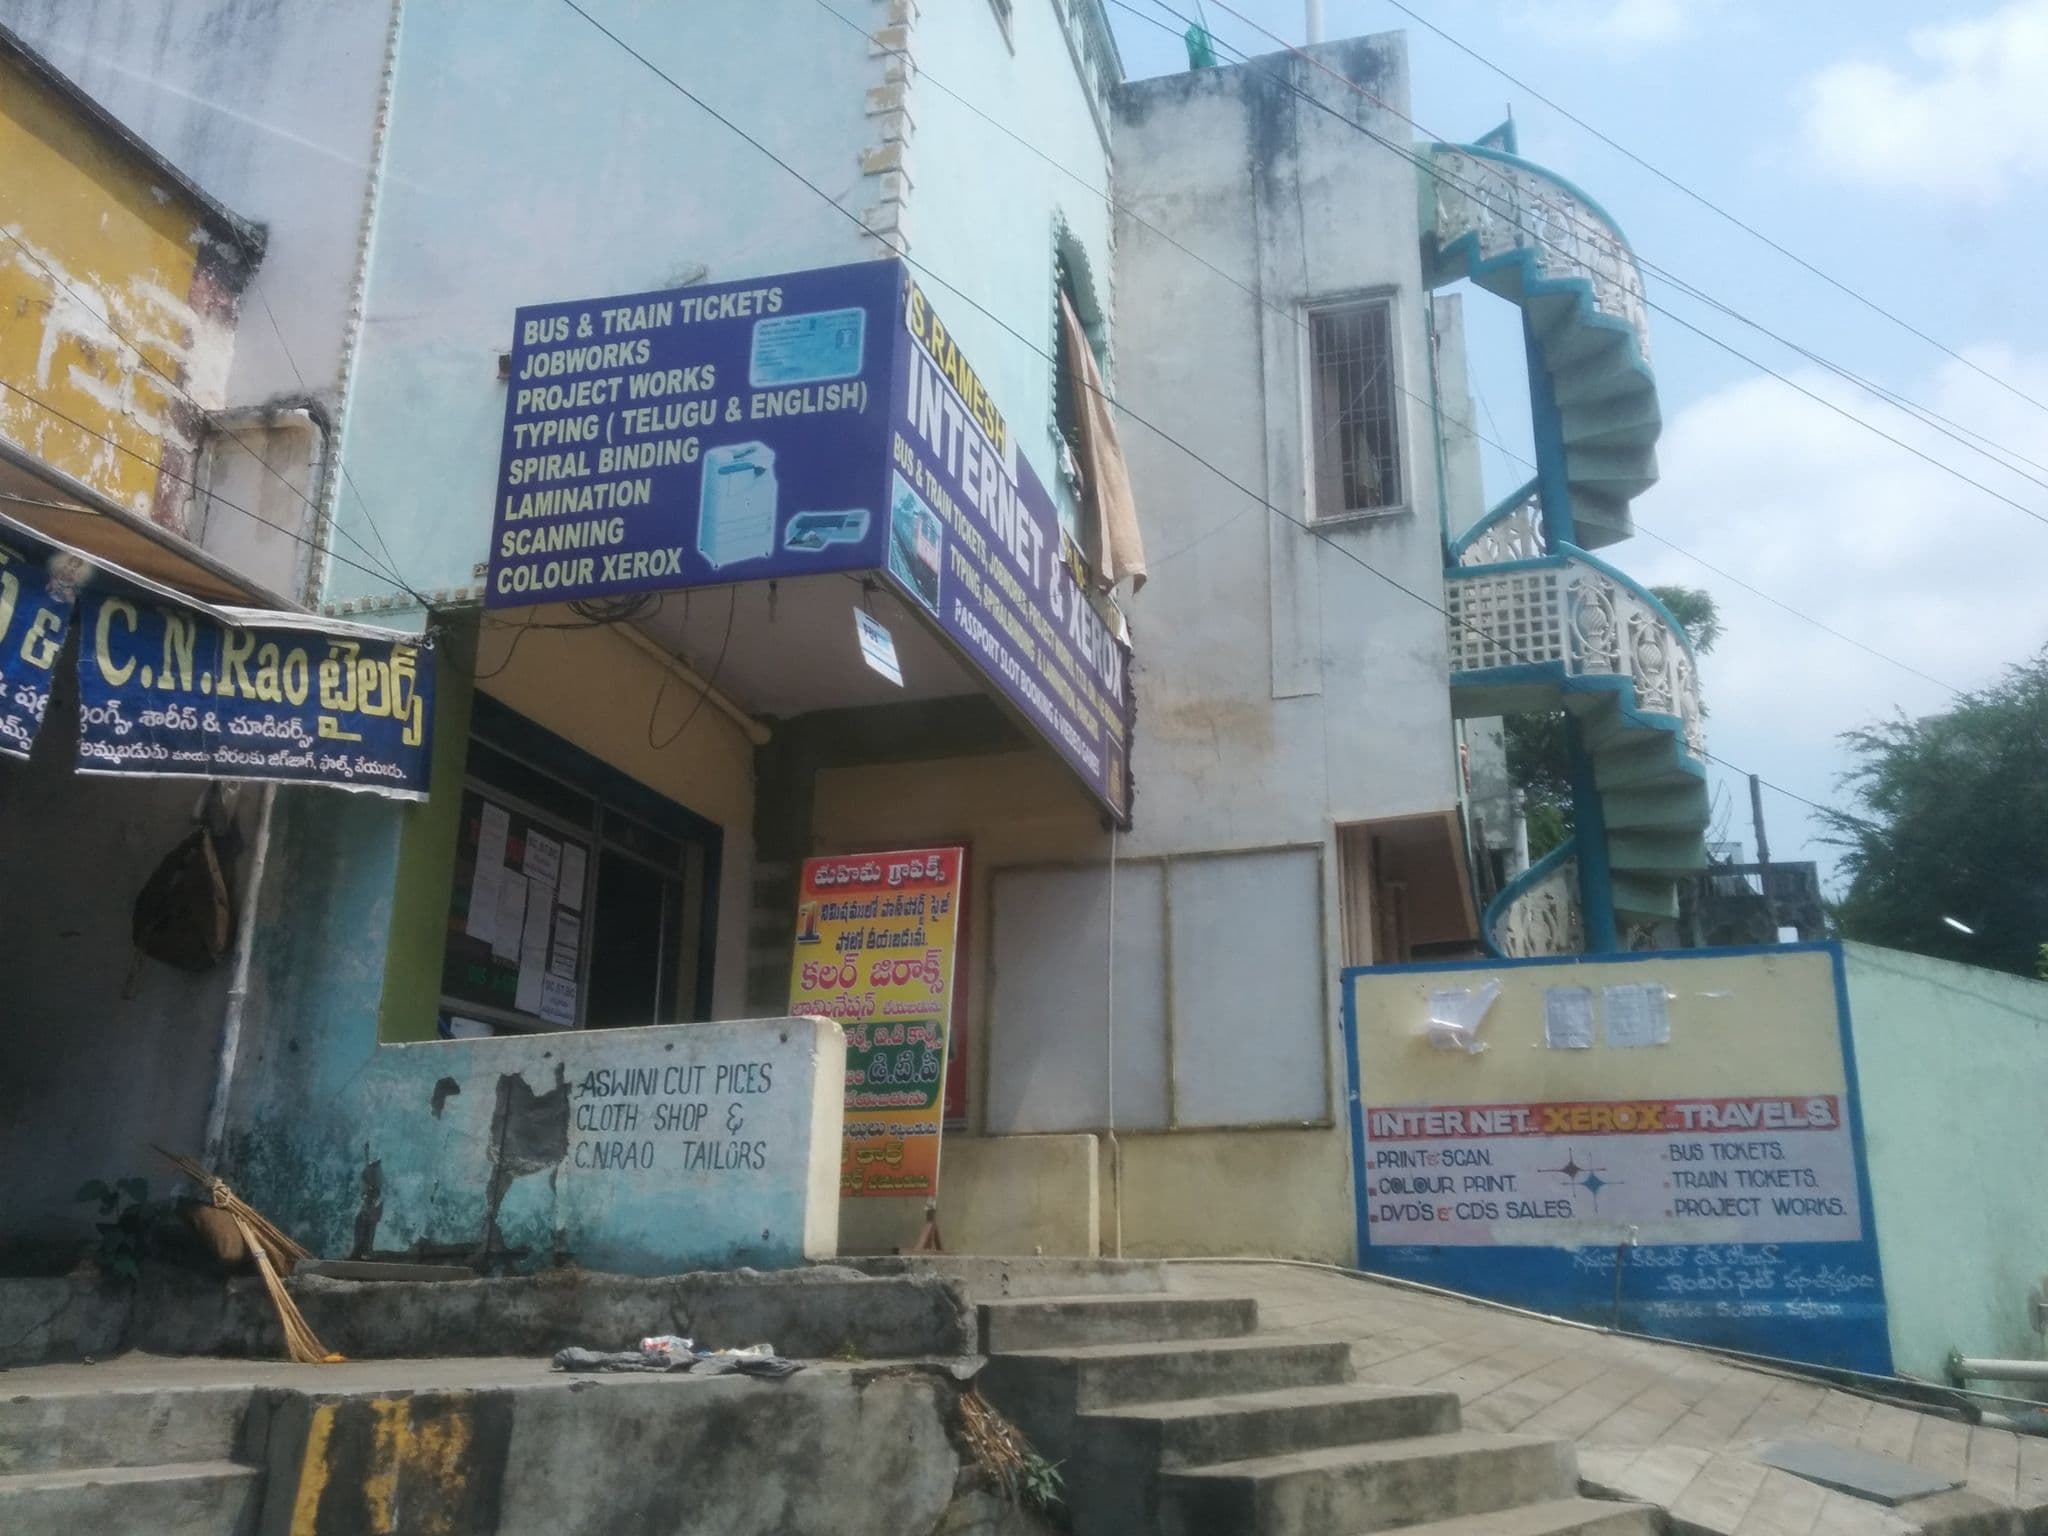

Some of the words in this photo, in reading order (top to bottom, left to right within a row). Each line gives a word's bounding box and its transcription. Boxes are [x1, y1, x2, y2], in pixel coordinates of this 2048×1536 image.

[523, 316, 569, 345] BUS
[577, 313, 593, 338] &
[602, 301, 672, 335] TRAIN
[680, 287, 783, 324] TICKETS
[519, 339, 650, 381] JOBWORKS
[911, 287, 1007, 461] S.RAMESH
[516, 376, 622, 414] PROJECT
[629, 364, 716, 400] WORKS
[514, 414, 599, 449] TYPING
[622, 399, 717, 436] TELUGU
[725, 397, 743, 423] &
[750, 381, 868, 420] ENGLISH)
[508, 451, 591, 486] SPIRAL
[598, 436, 700, 474] BINDING
[893, 431, 914, 477] BUS
[915, 458, 923, 488] &
[925, 469, 953, 523] TRAIN
[505, 478, 652, 521] LAMINATION
[500, 517, 625, 557] SCANNING
[907, 341, 1044, 590] INTERNET
[1049, 552, 1064, 623] &
[1069, 577, 1123, 706] XEROX
[497, 556, 594, 594] COLOUR
[602, 547, 684, 583] XEROX
[95, 599, 310, 707] C.N.Rao
[954, 596, 1000, 661] PASSPORT
[1000, 646, 1020, 685] SLOT
[202, 711, 222, 734] &
[796, 901, 822, 944] 1
[800, 952, 860, 991] కలర్
[869, 949, 945, 994] జిరాక్స్
[579, 1067, 659, 1098] ASWINI
[663, 1065, 706, 1095] CUT
[715, 1062, 773, 1095] PICES
[576, 1103, 638, 1132] CLOTH
[654, 1102, 709, 1132] SHOP
[682, 1140, 767, 1170] TAILORS
[1377, 1149, 1427, 1169] PRINT
[1670, 1143, 1704, 1162] BUS
[1379, 1176, 1456, 1194] COLOUR
[1672, 1169, 1728, 1189] TRAIN
[1381, 1200, 1434, 1222] DVD'S
[1675, 1197, 1760, 1217] PROJECT
